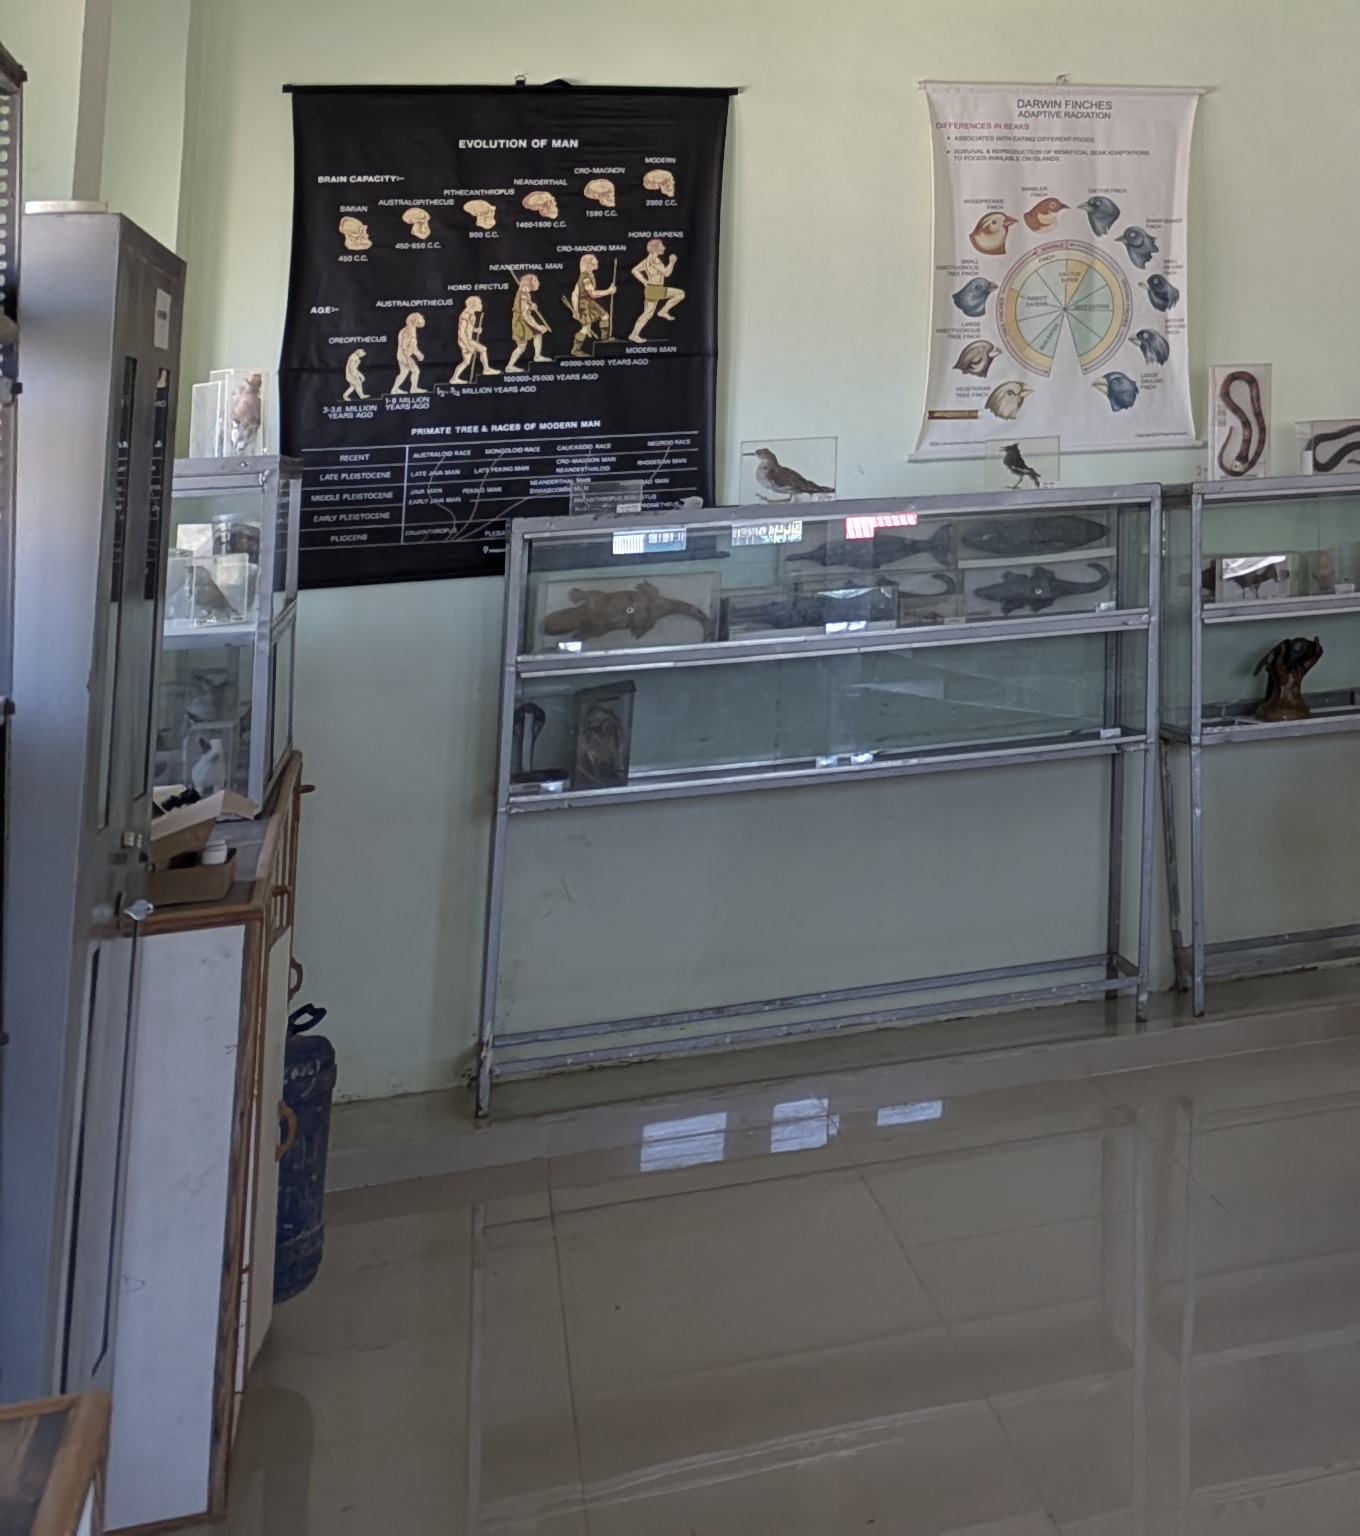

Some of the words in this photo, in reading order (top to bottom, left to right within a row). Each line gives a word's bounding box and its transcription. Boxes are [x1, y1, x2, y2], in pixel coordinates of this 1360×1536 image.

[1017, 99, 1061, 109] DARWIN
[1064, 100, 1112, 110] FINCHES
[1017, 111, 1061, 119] ADAPTIVE
[1064, 111, 1111, 119] RADIATION
[936, 122, 992, 130] DIFFERENCES
[458, 139, 527, 149] EVOLUTION
[532, 139, 547, 148] OF
[552, 139, 578, 148] MAN
[376, 299, 453, 307] AUSTRALOPITHECUS
[329, 336, 387, 344] OREOPITHECUS
[411, 427, 452, 435] PRIMATE
[455, 425, 479, 433] TREE
[491, 423, 521, 432] RACES
[524, 422, 536, 430] OF
[539, 421, 578, 430] MODERN
[340, 454, 370, 462] RECENT
[320, 473, 338, 481] LATE
[341, 471, 391, 480] PLEISTOCENE
[311, 493, 340, 501] MIDDLE
[343, 492, 393, 500] PLEISTOCENE
[339, 512, 390, 521] PLEISTOCENE
[330, 534, 368, 542] PLIOCENE
